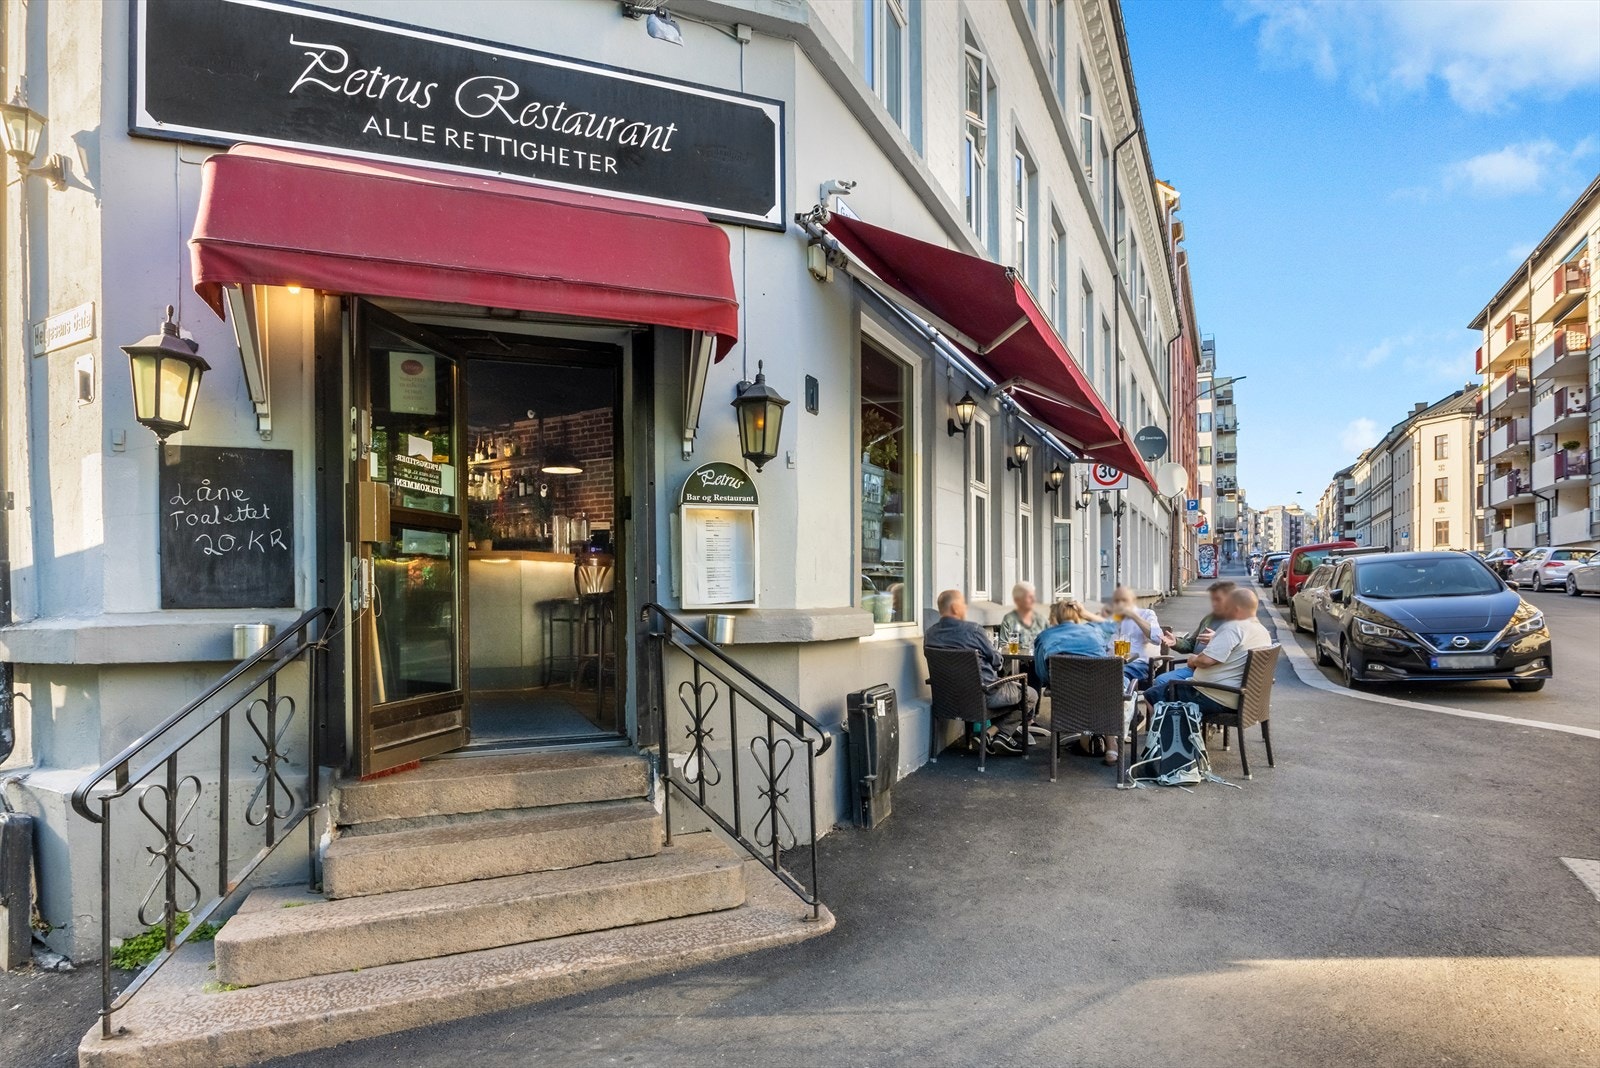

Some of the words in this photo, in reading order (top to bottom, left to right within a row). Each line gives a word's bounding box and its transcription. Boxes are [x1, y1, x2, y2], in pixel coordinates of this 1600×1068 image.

[289, 33, 439, 109] Petrus
[454, 75, 679, 153] Restaurant
[362, 115, 436, 145] ALLE
[445, 130, 619, 175] RETTIGHETER
[696, 469, 745, 489] Petrus
[1098, 463, 1117, 478] 30
[169, 479, 250, 506] Låne
[686, 493, 700, 501] Bar
[702, 494, 712, 502] og
[713, 494, 754, 502] Restaurant
[1189, 501, 1196, 510] P
